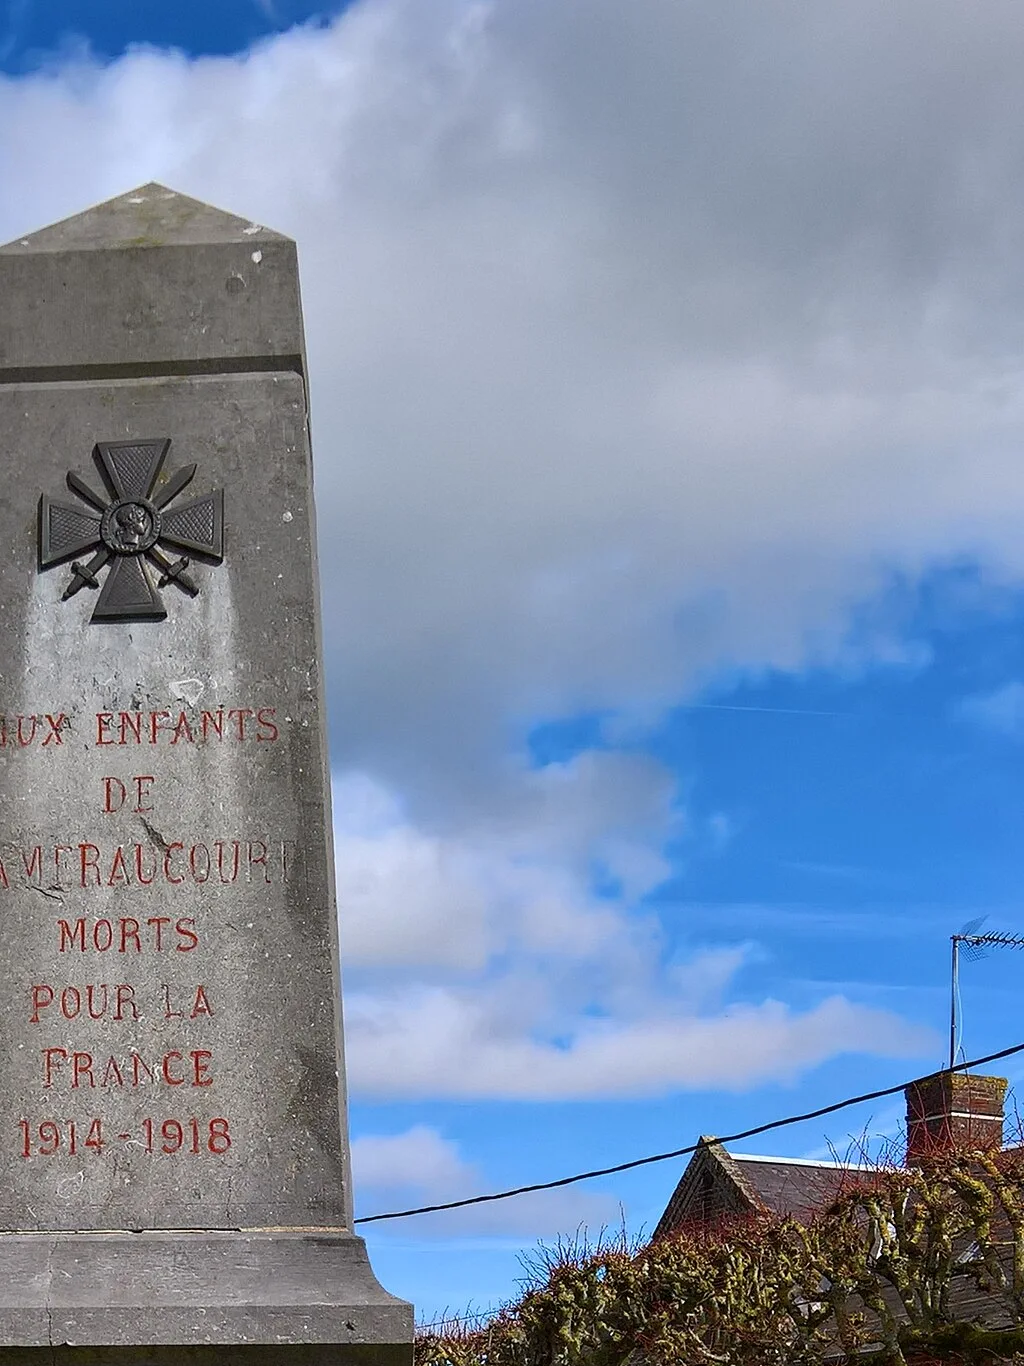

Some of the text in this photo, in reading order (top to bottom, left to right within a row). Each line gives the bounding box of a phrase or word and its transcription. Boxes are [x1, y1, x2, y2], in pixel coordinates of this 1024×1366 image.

[94, 709, 278, 747] ENFANTS
[103, 775, 155, 814] DE
[55, 916, 200, 954] MORTS
[29, 983, 215, 1025] POUR LA
[43, 1045, 214, 1090] FRANCE
